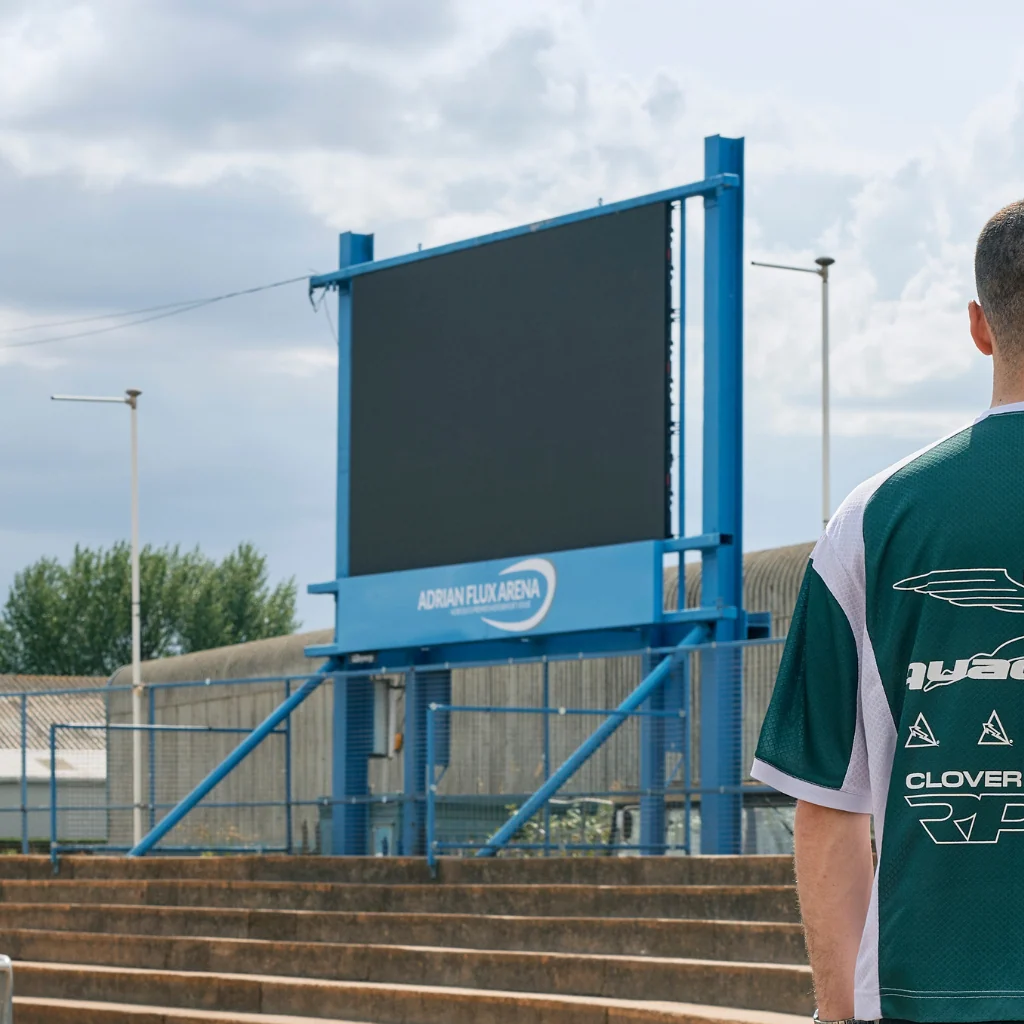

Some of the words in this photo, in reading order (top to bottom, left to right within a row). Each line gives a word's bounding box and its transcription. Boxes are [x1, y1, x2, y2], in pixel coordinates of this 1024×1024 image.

[417, 586, 464, 611] ADRIAN
[466, 582, 497, 605] FLUX
[497, 577, 541, 601] ARENA
[905, 770, 1022, 788] CLOVER
